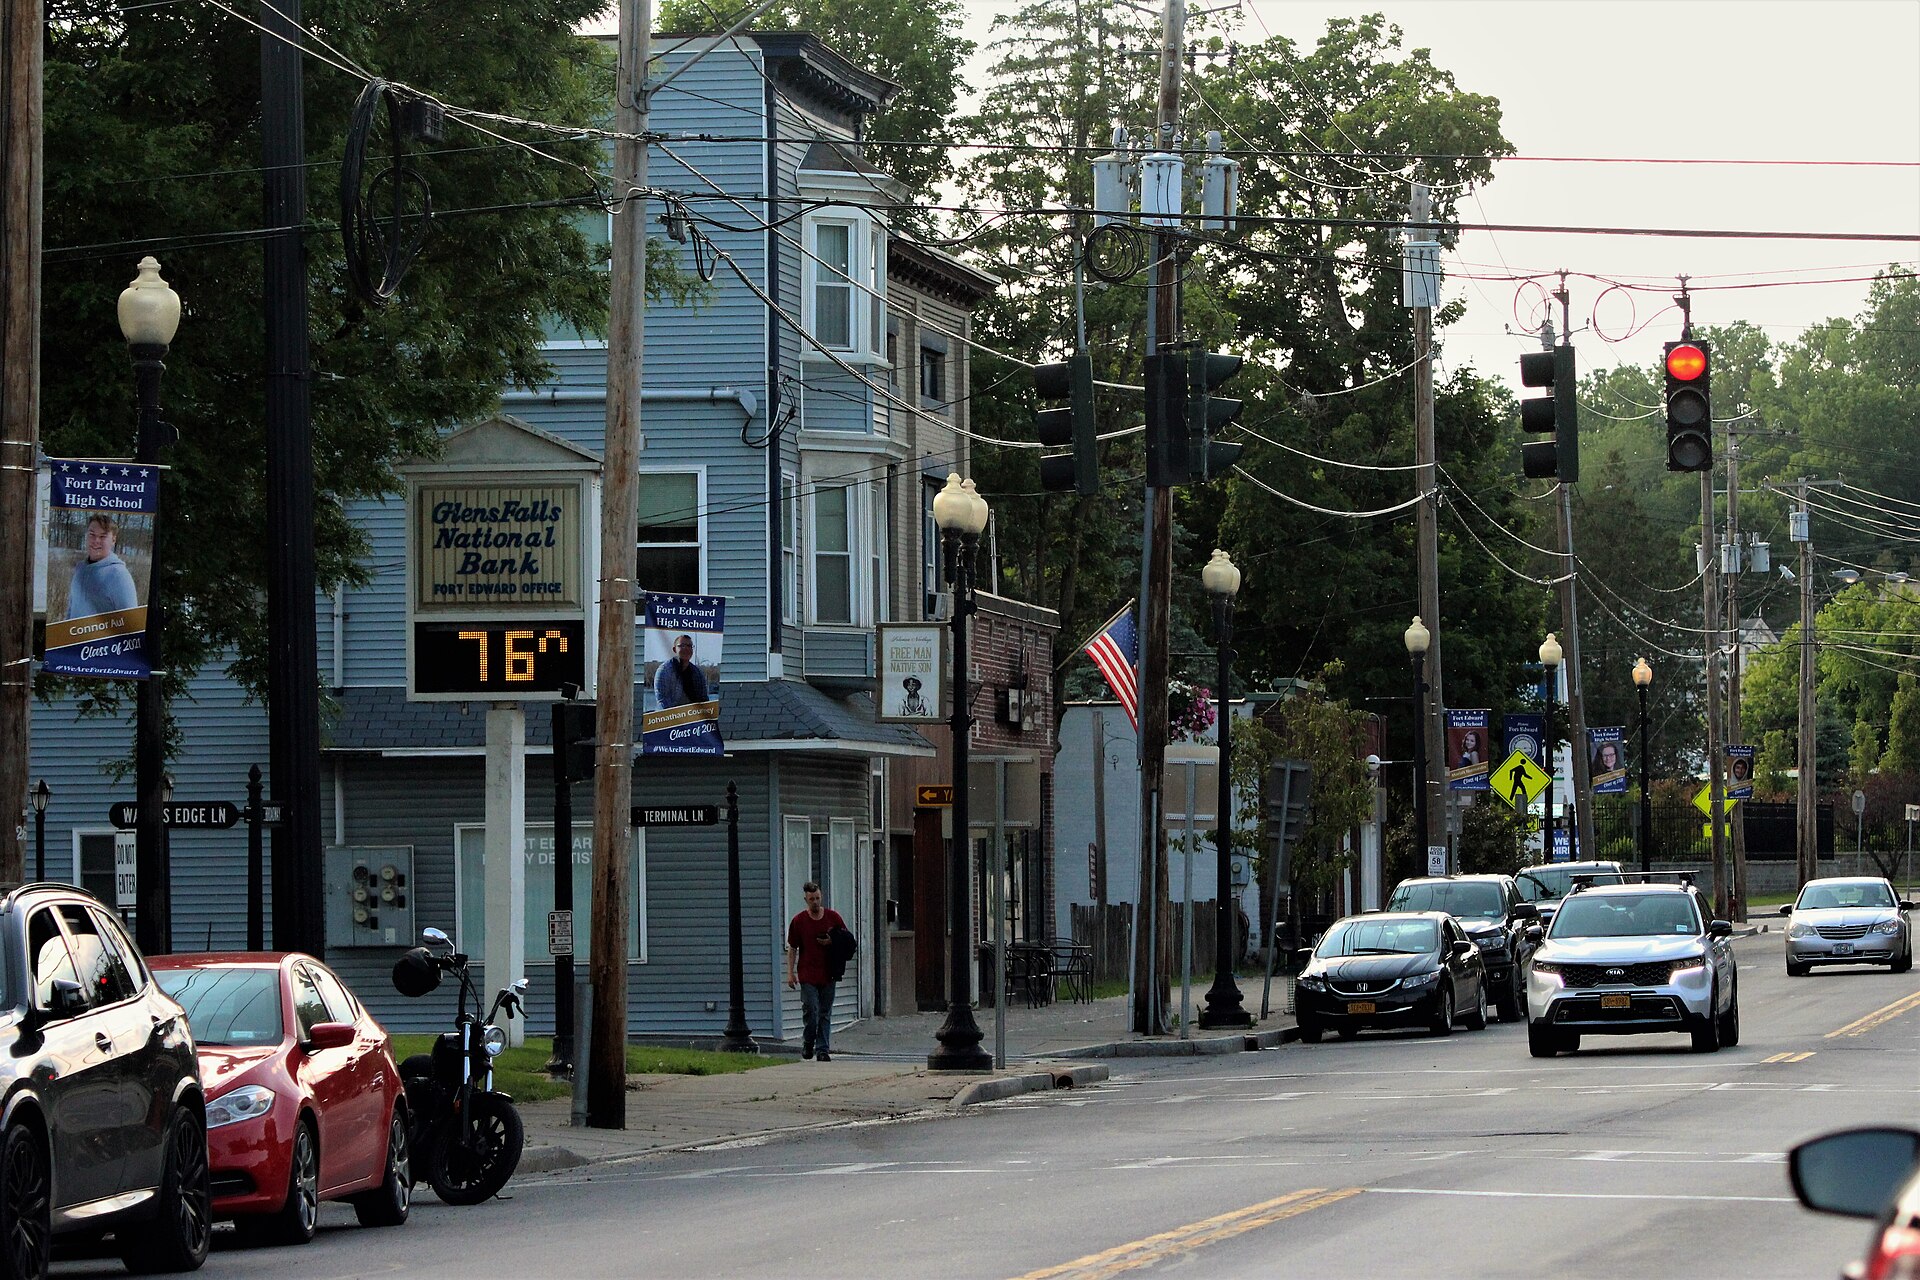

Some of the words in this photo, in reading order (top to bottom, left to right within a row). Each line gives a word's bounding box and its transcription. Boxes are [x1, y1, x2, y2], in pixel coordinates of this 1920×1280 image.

[65, 477, 92, 489] Fort
[95, 479, 145, 493] Edward
[65, 493, 96, 508] High
[99, 495, 143, 509] School
[433, 526, 556, 548] National
[456, 552, 539, 575] Bank
[433, 583, 464, 595] FORT
[468, 583, 517, 594] EDWARD
[522, 582, 562, 594] OFFICE
[655, 605, 676, 615] Fort
[678, 606, 716, 617] Edward
[69, 621, 108, 636] Connor
[656, 617, 679, 629] High
[681, 619, 714, 629] School
[80, 645, 108, 661] Class
[111, 642, 122, 656] of
[123, 637, 141, 651] 2021
[890, 646, 911, 659] FREE
[914, 646, 932, 659] MAN
[56, 665, 139, 675] #WeAreFortEdward
[890, 662, 916, 673] NATIVE
[918, 662, 932, 673] SON
[647, 712, 686, 725] Johnathan
[669, 728, 691, 741] Class
[692, 726, 701, 737] of
[701, 723, 716, 734] 202
[176, 807, 206, 823] EDGE
[211, 807, 226, 823] LN
[644, 810, 689, 822] TERMINAL
[692, 810, 704, 822] LN
[117, 844, 125, 865] DO
[125, 844, 135, 865] NOT
[118, 873, 136, 895] ENTER
